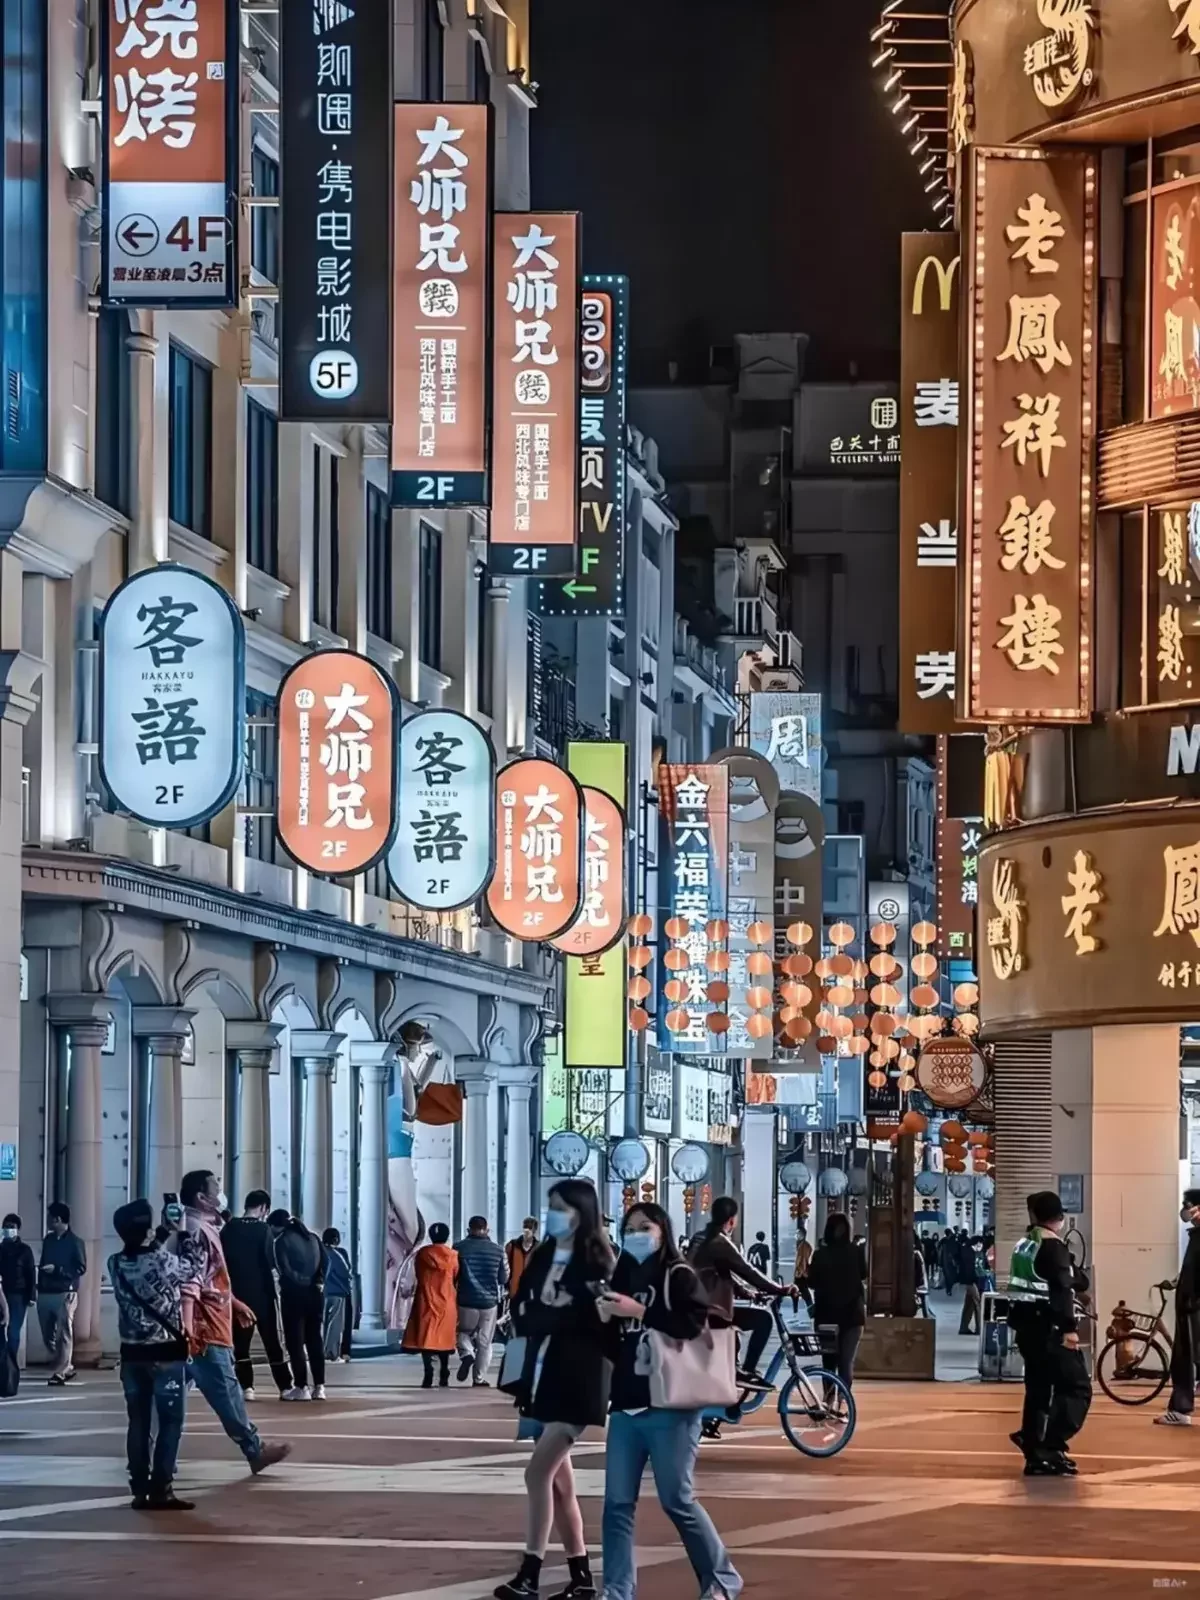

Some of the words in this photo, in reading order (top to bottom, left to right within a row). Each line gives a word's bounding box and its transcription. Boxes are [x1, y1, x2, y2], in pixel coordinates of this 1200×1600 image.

[113, 0, 199, 148] 烧烤
[410, 116, 469, 273] 大师兄
[166, 216, 226, 252] 4F
[506, 224, 559, 366] 大师兄
[316, 362, 352, 389] 5F
[996, 193, 1072, 675] 老鳳祥銀樓
[416, 477, 454, 500] 2F
[513, 547, 548, 569] 2F
[132, 596, 206, 766] 客語
[155, 785, 185, 805] 2F
[319, 683, 374, 830] 大师兄
[410, 732, 468, 864] 客語
[321, 840, 348, 858] 2F
[520, 784, 564, 903] 大师兄
[427, 878, 450, 894] 2F
[522, 911, 545, 926] 2F
